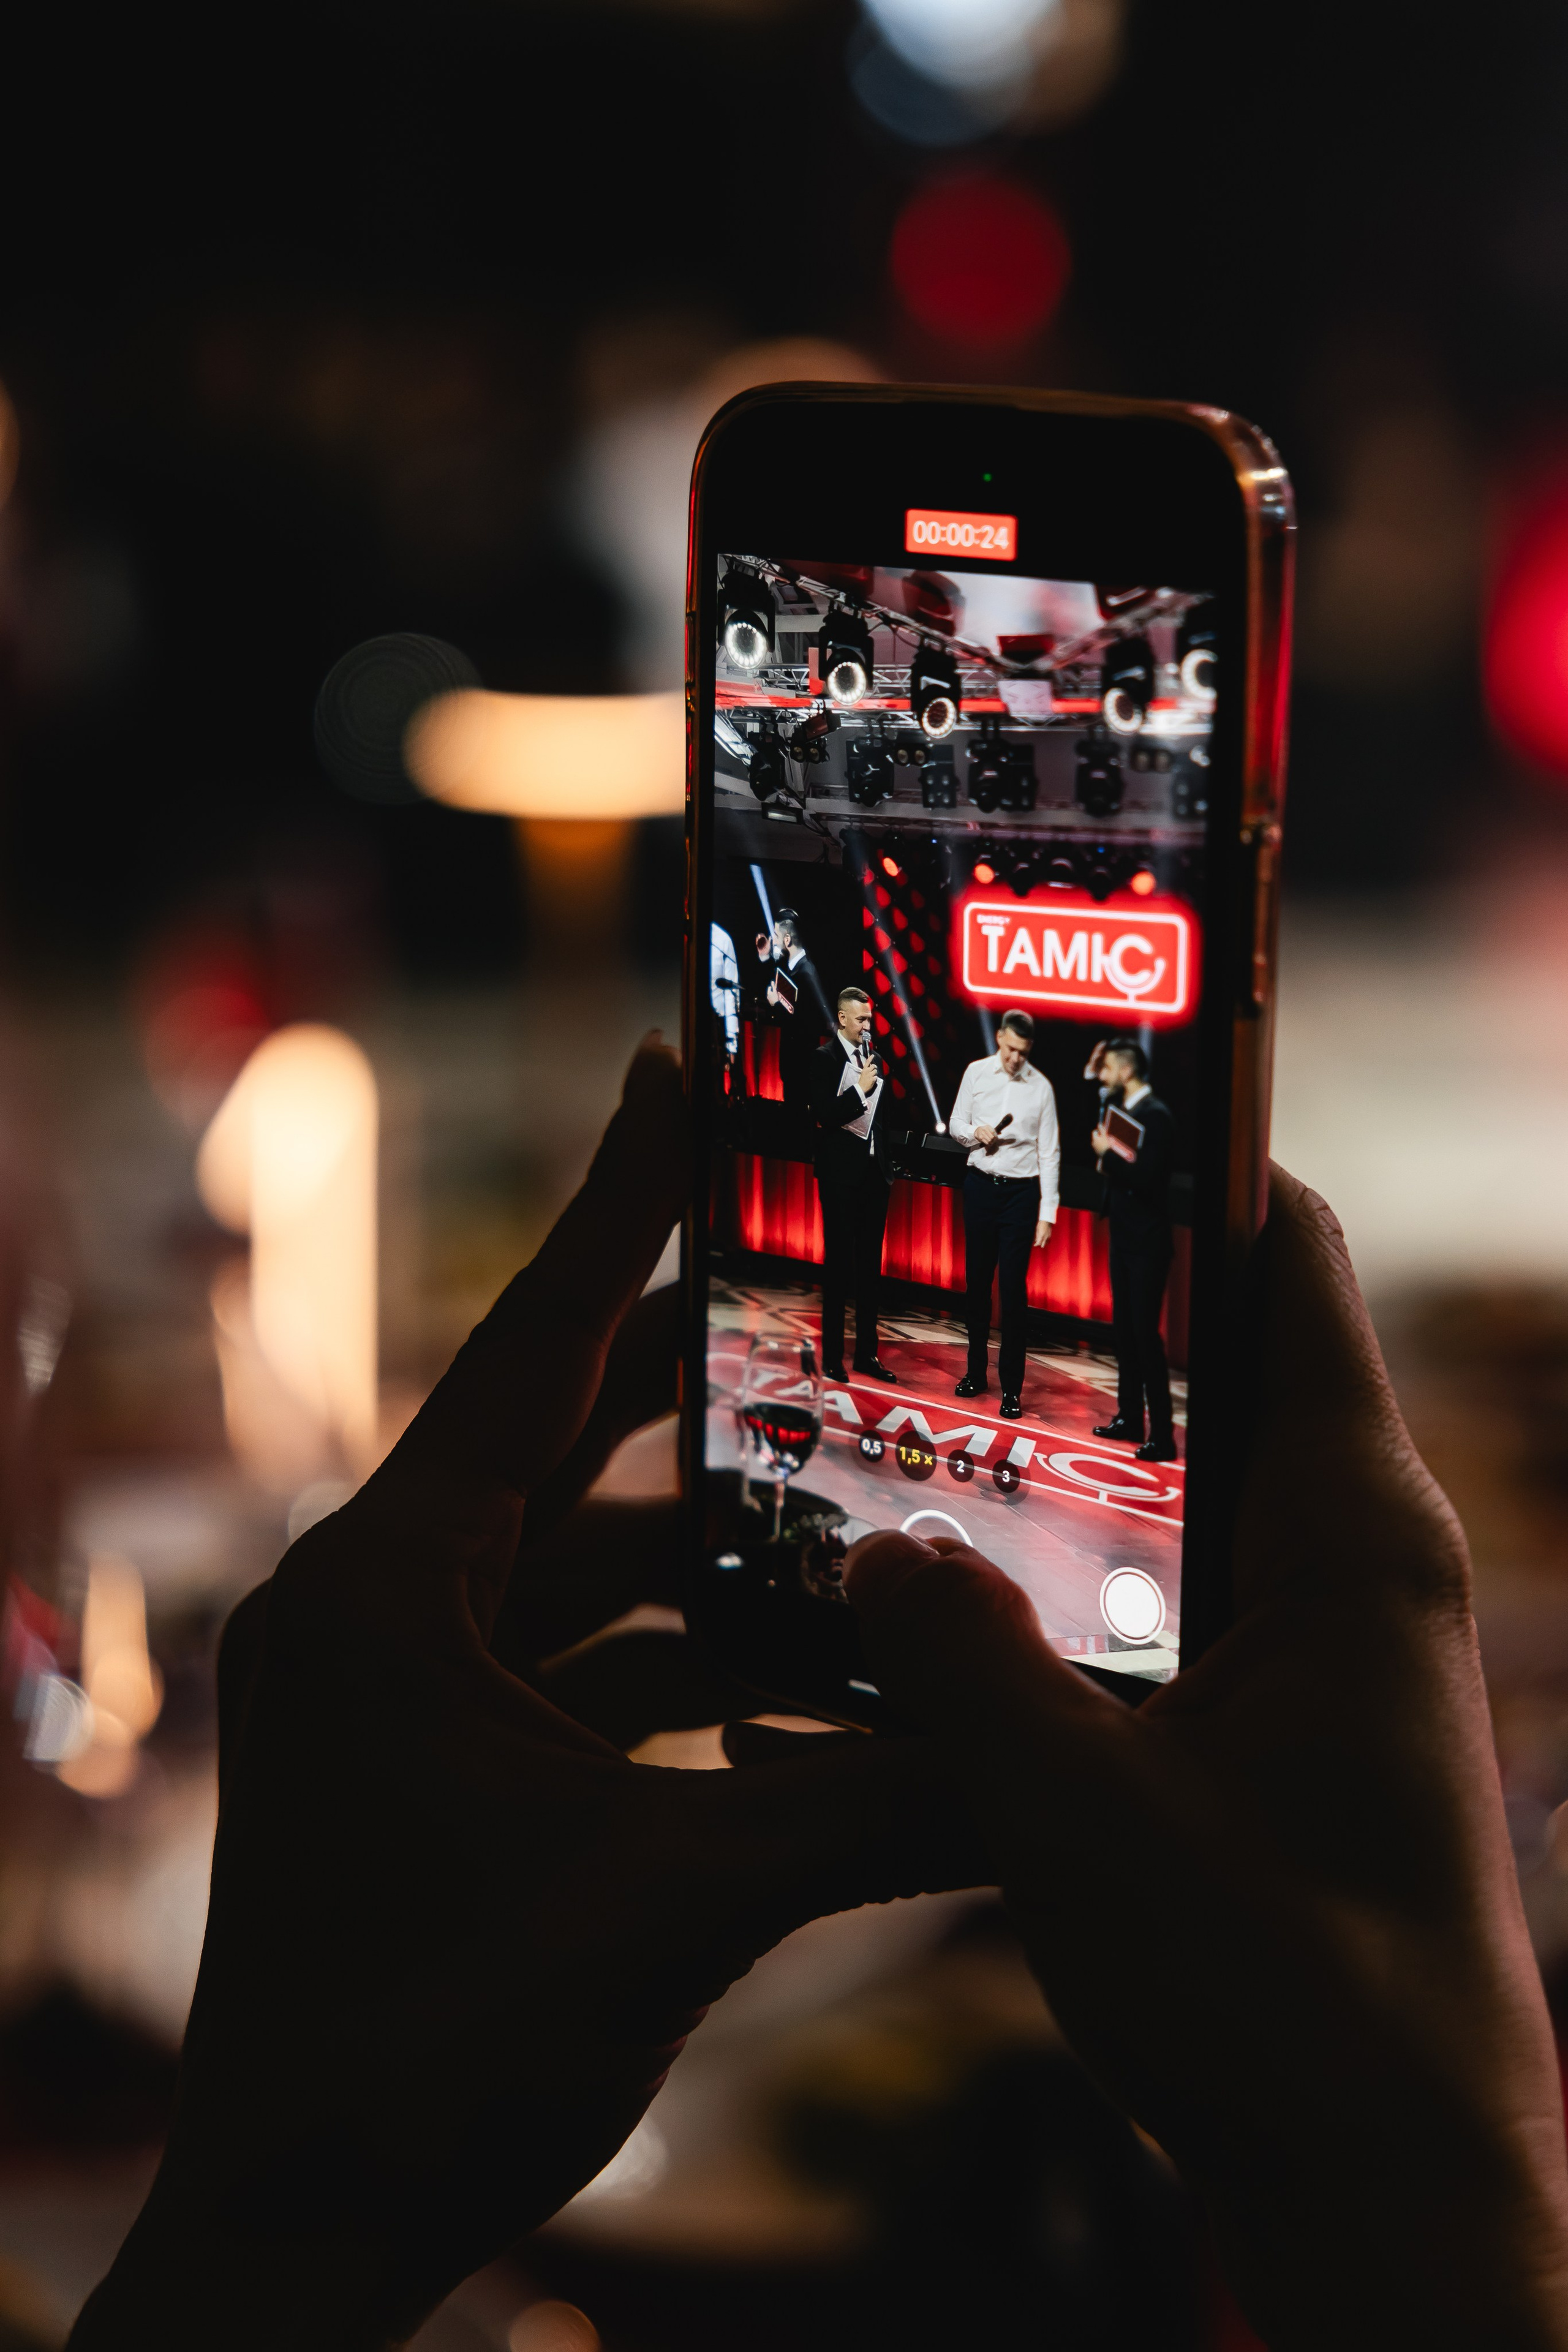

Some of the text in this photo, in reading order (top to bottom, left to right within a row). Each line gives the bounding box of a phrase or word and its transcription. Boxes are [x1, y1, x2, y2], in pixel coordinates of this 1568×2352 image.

[913, 520, 1009, 549] 00:00:24
[981, 924, 1159, 988] TAMIC
[861, 1439, 1011, 1483] 0,5 1,5 x 2 3
